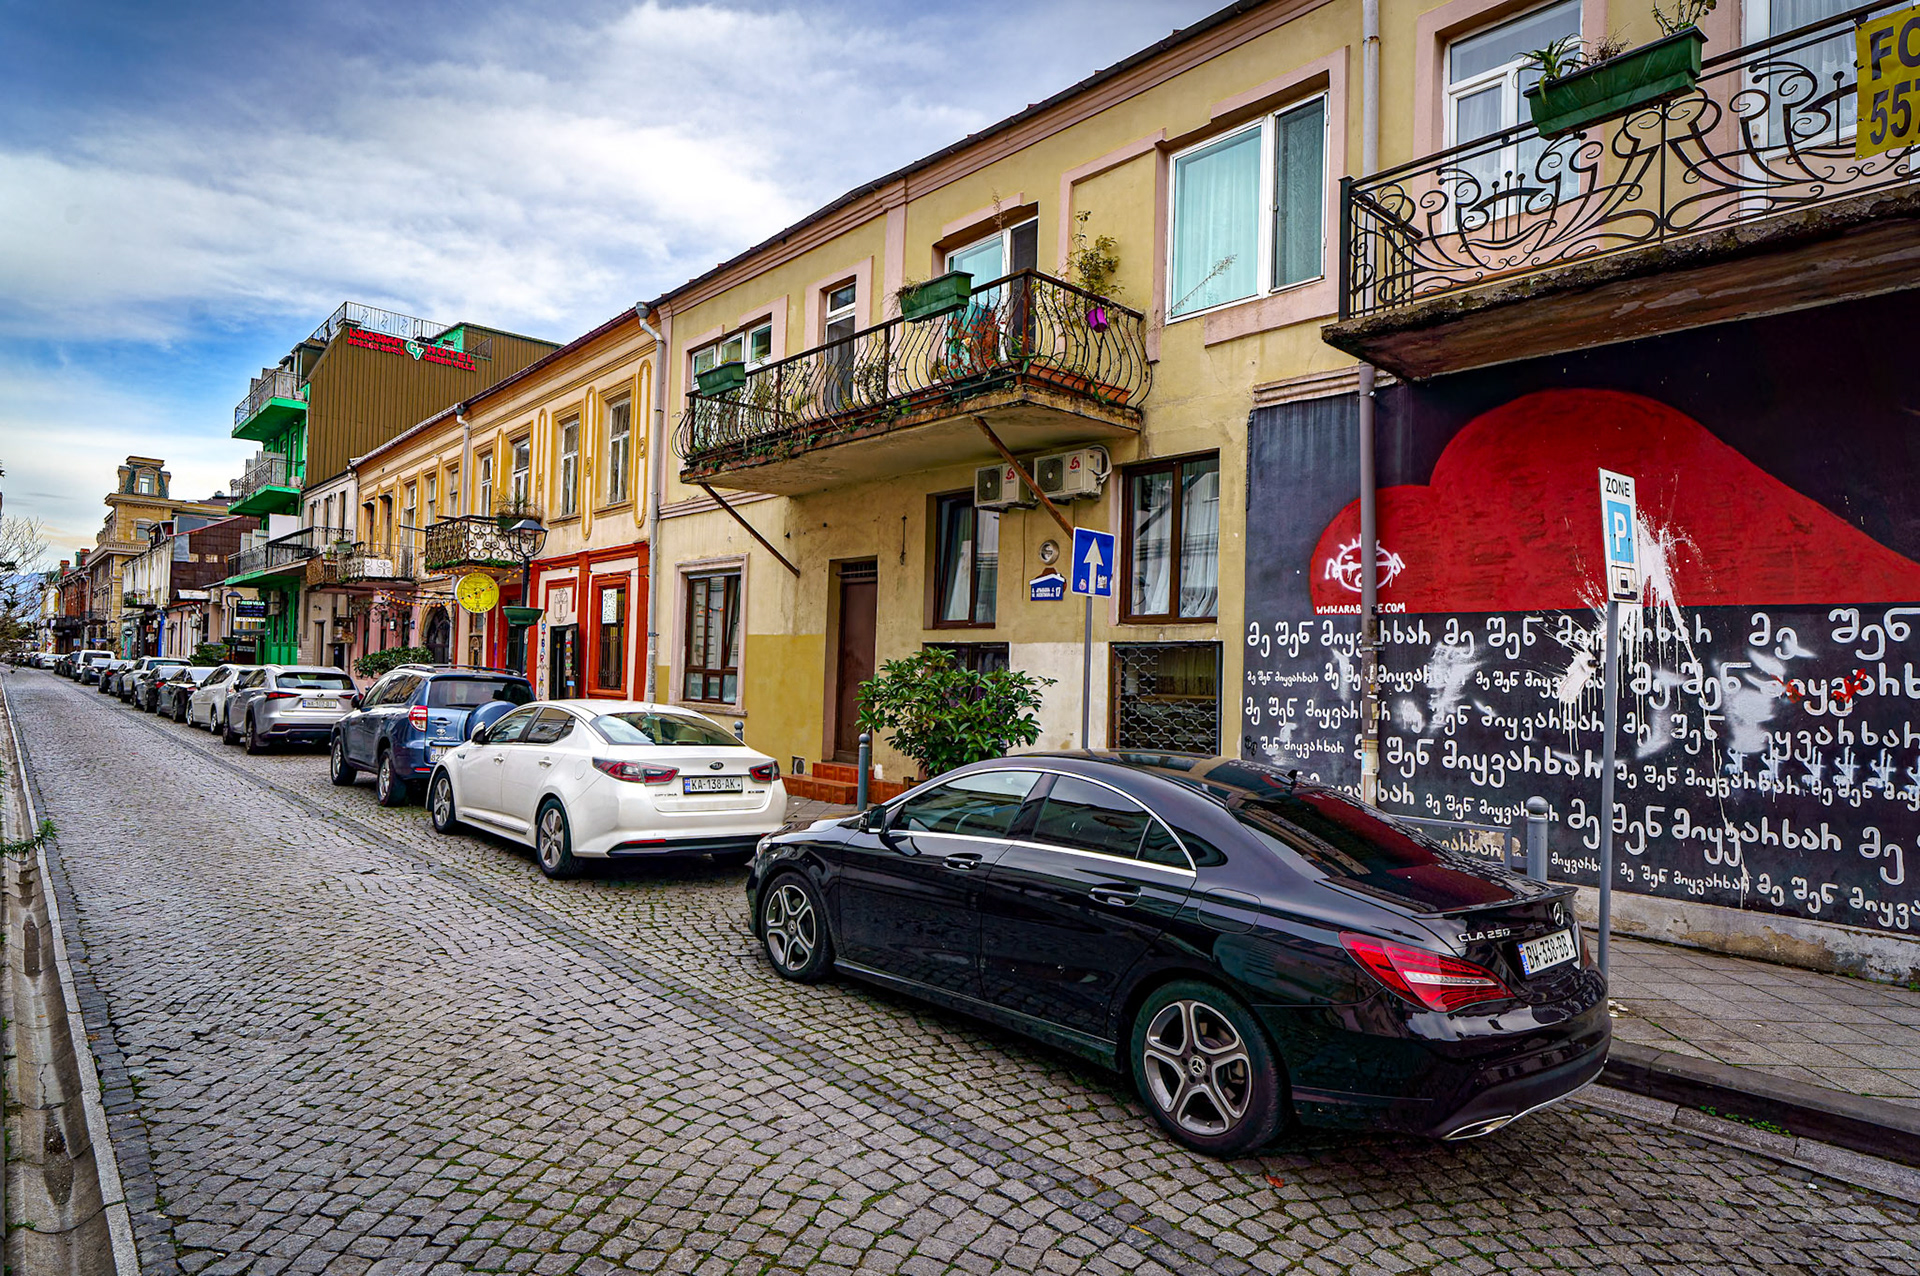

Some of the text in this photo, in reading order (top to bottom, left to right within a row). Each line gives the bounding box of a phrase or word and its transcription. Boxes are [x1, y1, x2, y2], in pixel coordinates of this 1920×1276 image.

[1870, 79, 1920, 145] 55
[424, 354, 476, 371] GREEN VILLA
[427, 345, 475, 364] HOTEL
[1605, 476, 1631, 498] ZONE
[1613, 511, 1627, 553] P
[1247, 621, 1271, 658] მე
[1275, 621, 1314, 658] შენ
[1443, 617, 1475, 659] მე
[1486, 616, 1544, 660] შენ
[1748, 612, 1798, 660] მე
[1828, 607, 1920, 661] შენ
[1257, 670, 1274, 686] შენ
[1274, 671, 1319, 687] მიყვარხარ
[1323, 662, 1340, 690] მე
[1475, 671, 1490, 690] მე
[1493, 670, 1520, 693] შენ
[1630, 662, 1671, 710] მე
[1681, 662, 1751, 712] შენ
[1245, 696, 1260, 725] მე
[1268, 696, 1298, 726] შენ
[1670, 713, 1725, 755] შენ
[691, 778, 736, 791] KA-138-AK
[1386, 736, 1435, 778] შენ
[1442, 739, 1604, 788] მიყვარხარ
[1616, 762, 1637, 789] მე
[1643, 765, 1678, 792] შენ
[1425, 793, 1440, 815] მე
[1445, 794, 1474, 820] შენ
[1567, 798, 1600, 850] მე
[1671, 808, 1842, 867] მიყვარხარ
[1858, 826, 1905, 886] მე
[1620, 862, 1634, 882] მე
[1641, 864, 1668, 888] შენ
[1756, 873, 1784, 906] მე
[1791, 876, 1838, 914] შენ
[1458, 928, 1511, 943] CLA 250
